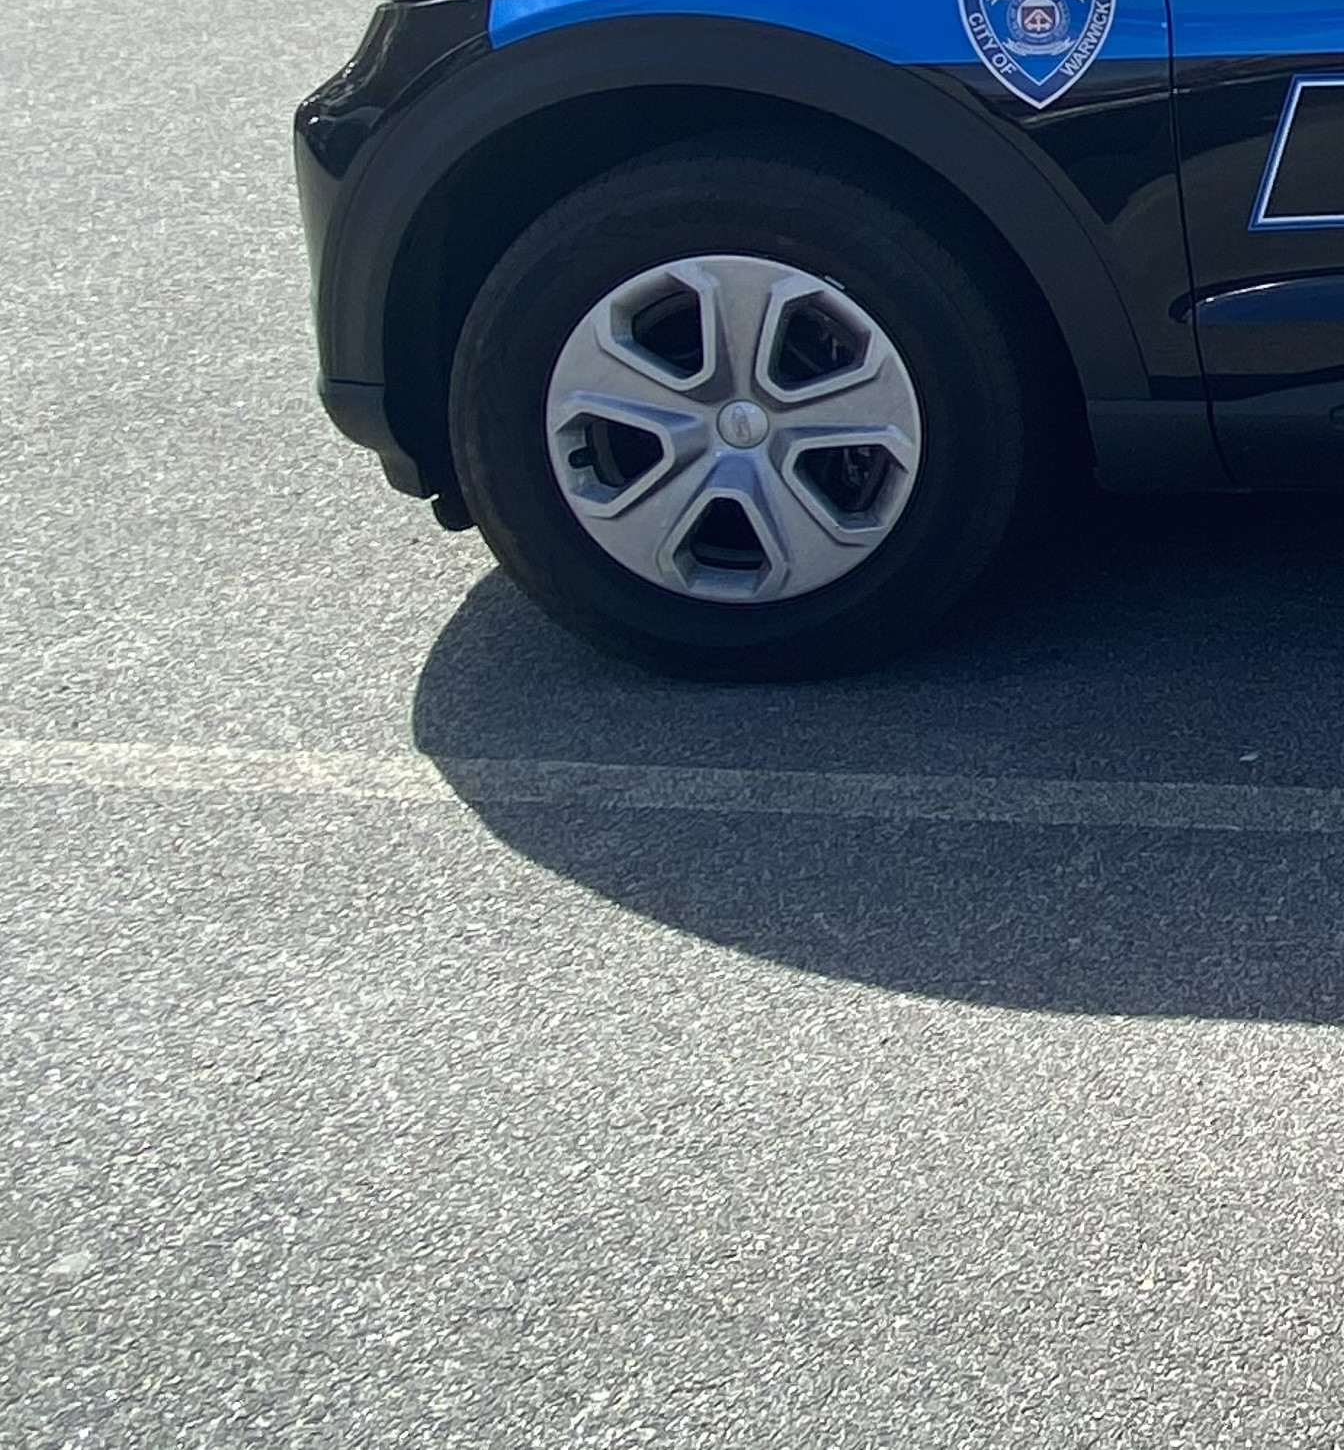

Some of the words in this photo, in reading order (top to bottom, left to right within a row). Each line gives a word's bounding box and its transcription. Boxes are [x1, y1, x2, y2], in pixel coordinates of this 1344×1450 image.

[967, 13, 997, 51] CITY
[992, 52, 1018, 76] OF
[1058, 0, 1111, 78] WARWICK
